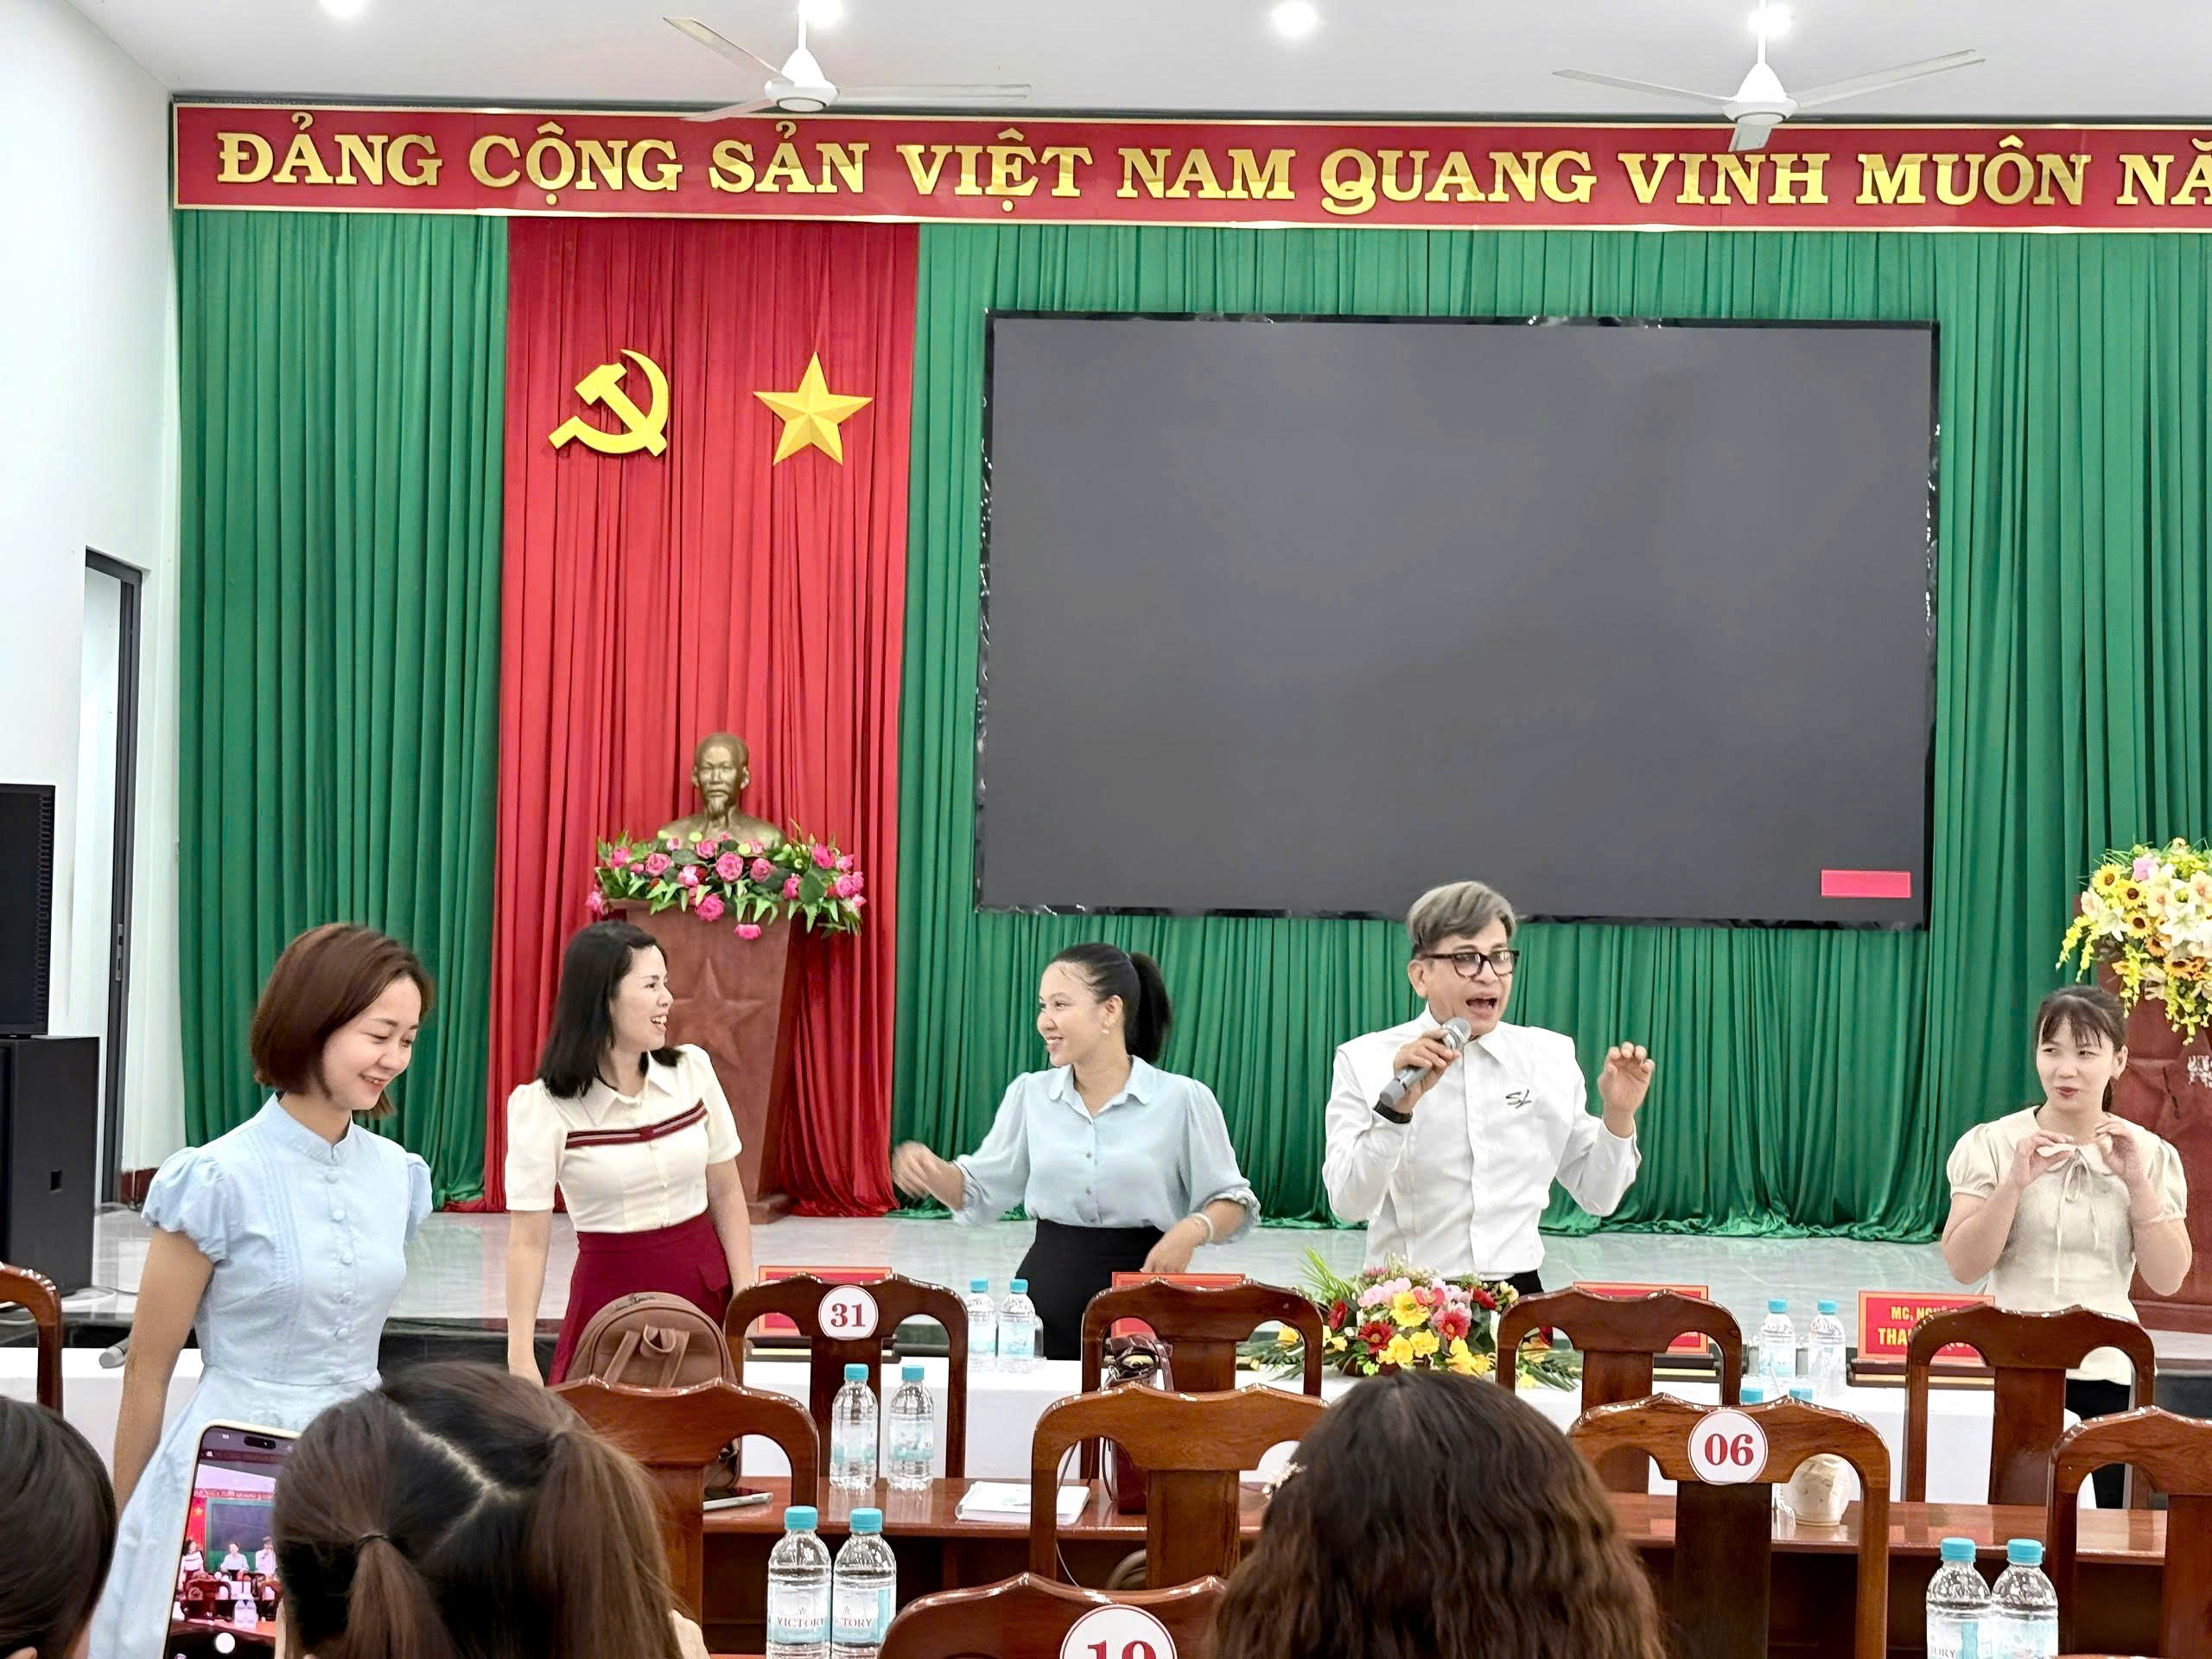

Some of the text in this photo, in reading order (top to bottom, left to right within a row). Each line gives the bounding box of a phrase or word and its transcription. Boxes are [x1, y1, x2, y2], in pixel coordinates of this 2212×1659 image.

[217, 111, 442, 188] ĐẢNG
[468, 122, 683, 205] CỘNG
[709, 120, 868, 194] SẢN
[896, 127, 1093, 213] VIỆT
[1116, 148, 1296, 200] NAM
[1319, 148, 1598, 215] QUANG
[1618, 153, 1830, 206] VINH
[1855, 135, 2091, 207] MUÔN
[830, 1302, 866, 1328] 31
[1704, 1433, 1754, 1466] 06
